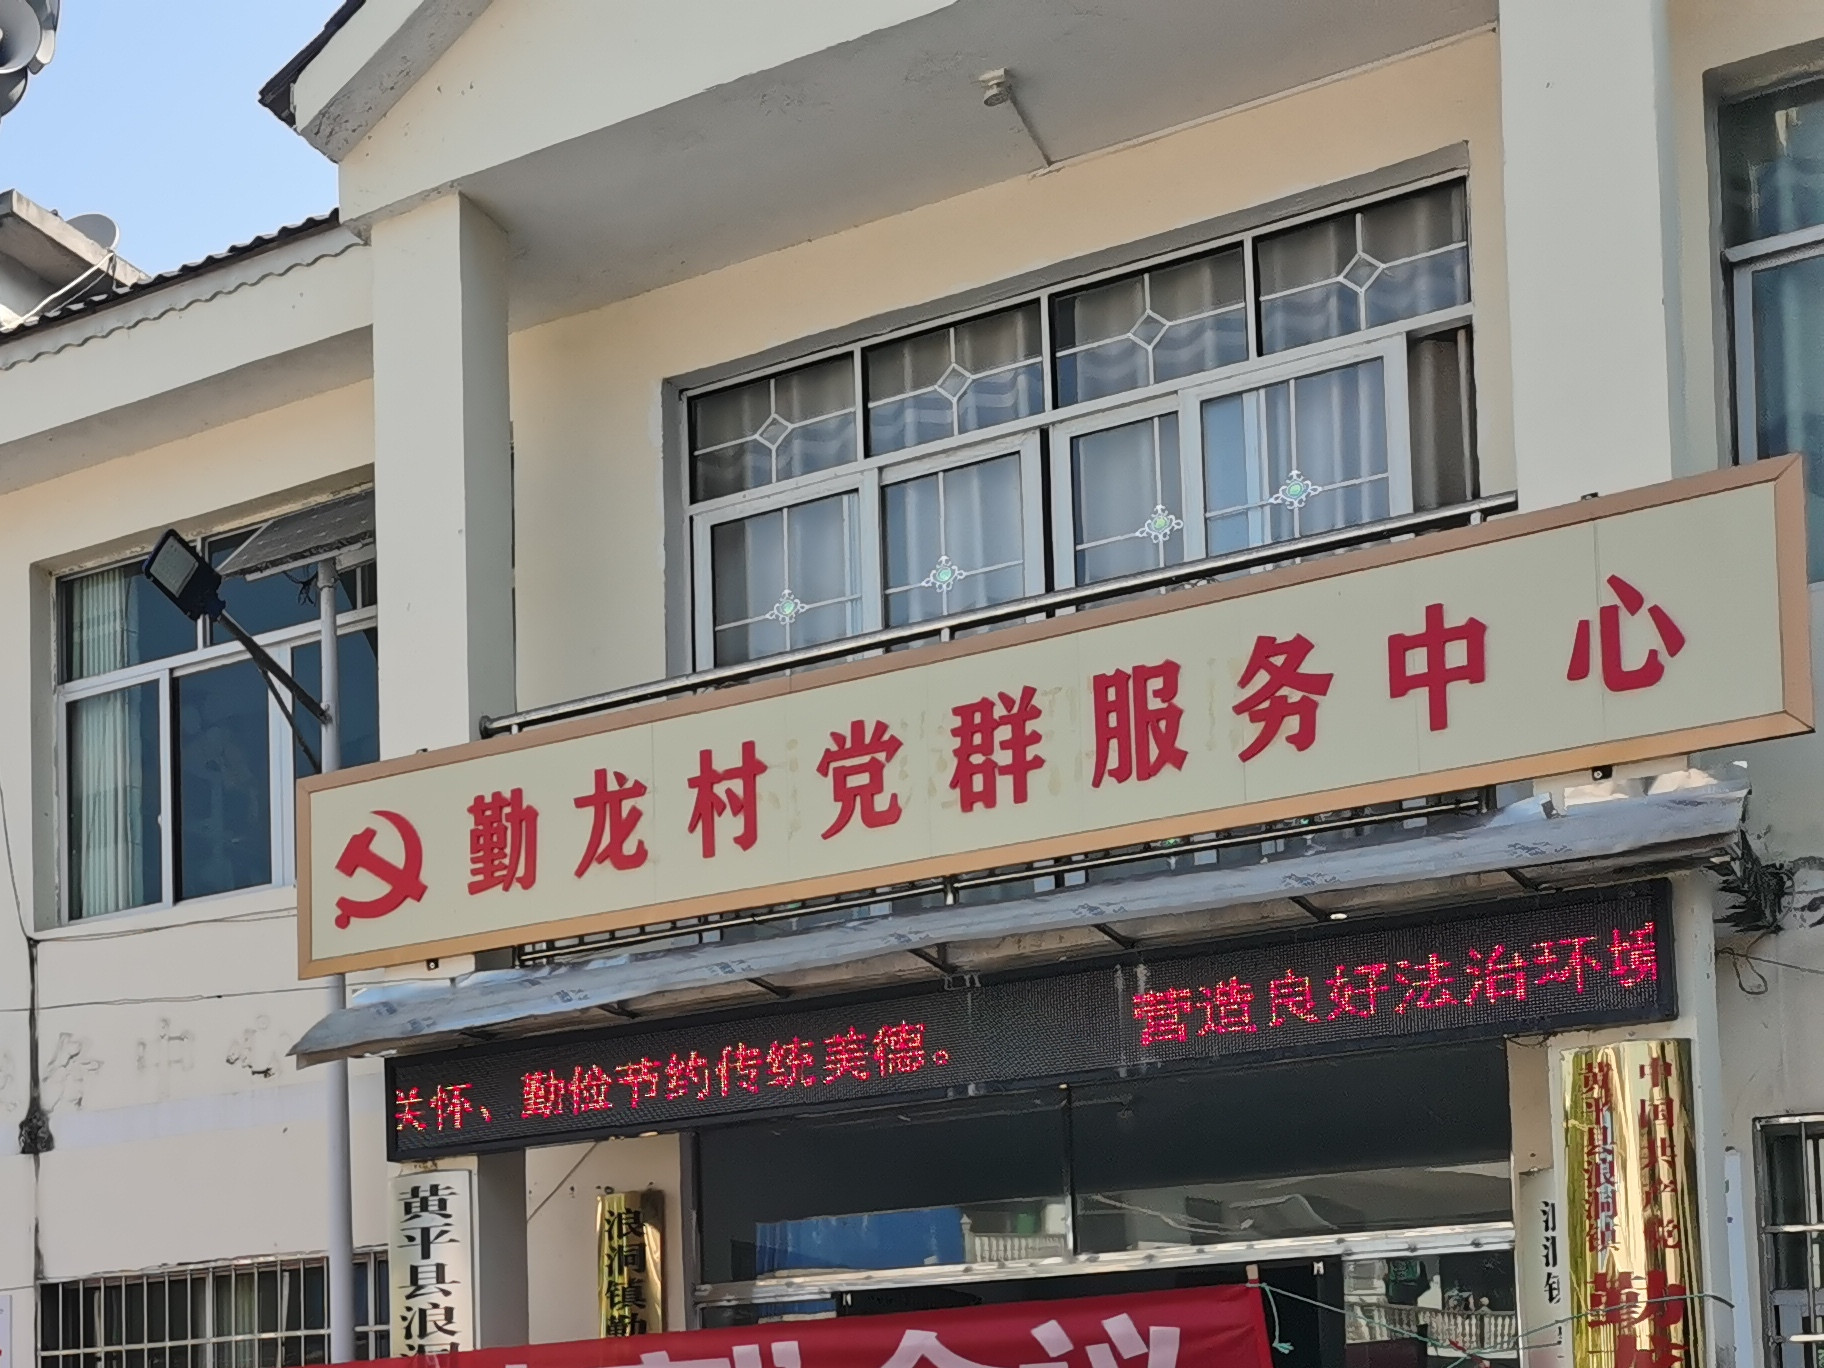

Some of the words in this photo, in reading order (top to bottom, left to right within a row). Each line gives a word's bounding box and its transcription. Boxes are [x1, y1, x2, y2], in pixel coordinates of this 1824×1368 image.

[469, 575, 1685, 894] 勤龙村党群服务中心
